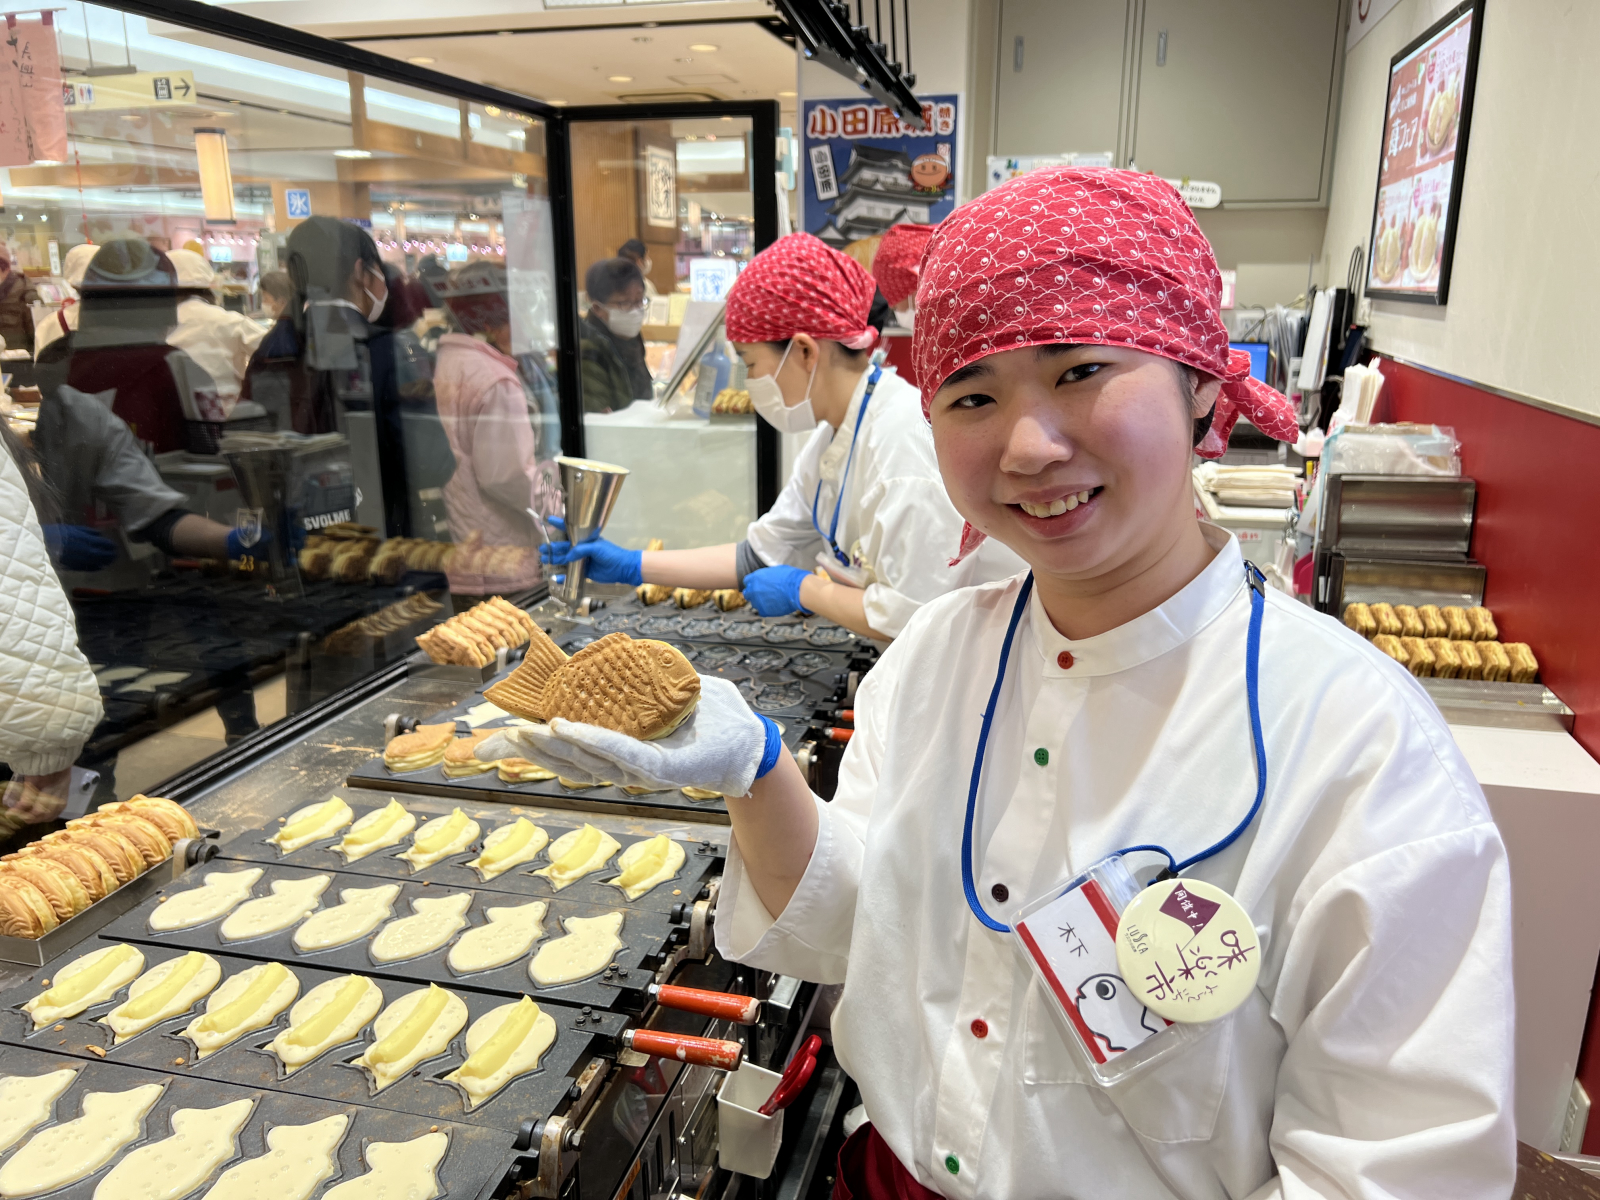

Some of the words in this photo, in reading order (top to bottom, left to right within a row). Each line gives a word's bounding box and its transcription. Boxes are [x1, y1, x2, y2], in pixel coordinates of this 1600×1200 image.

[303, 508, 351, 531] SVOLME
[1057, 921, 1089, 957] 木下
[1126, 924, 1149, 955] LUSCA
